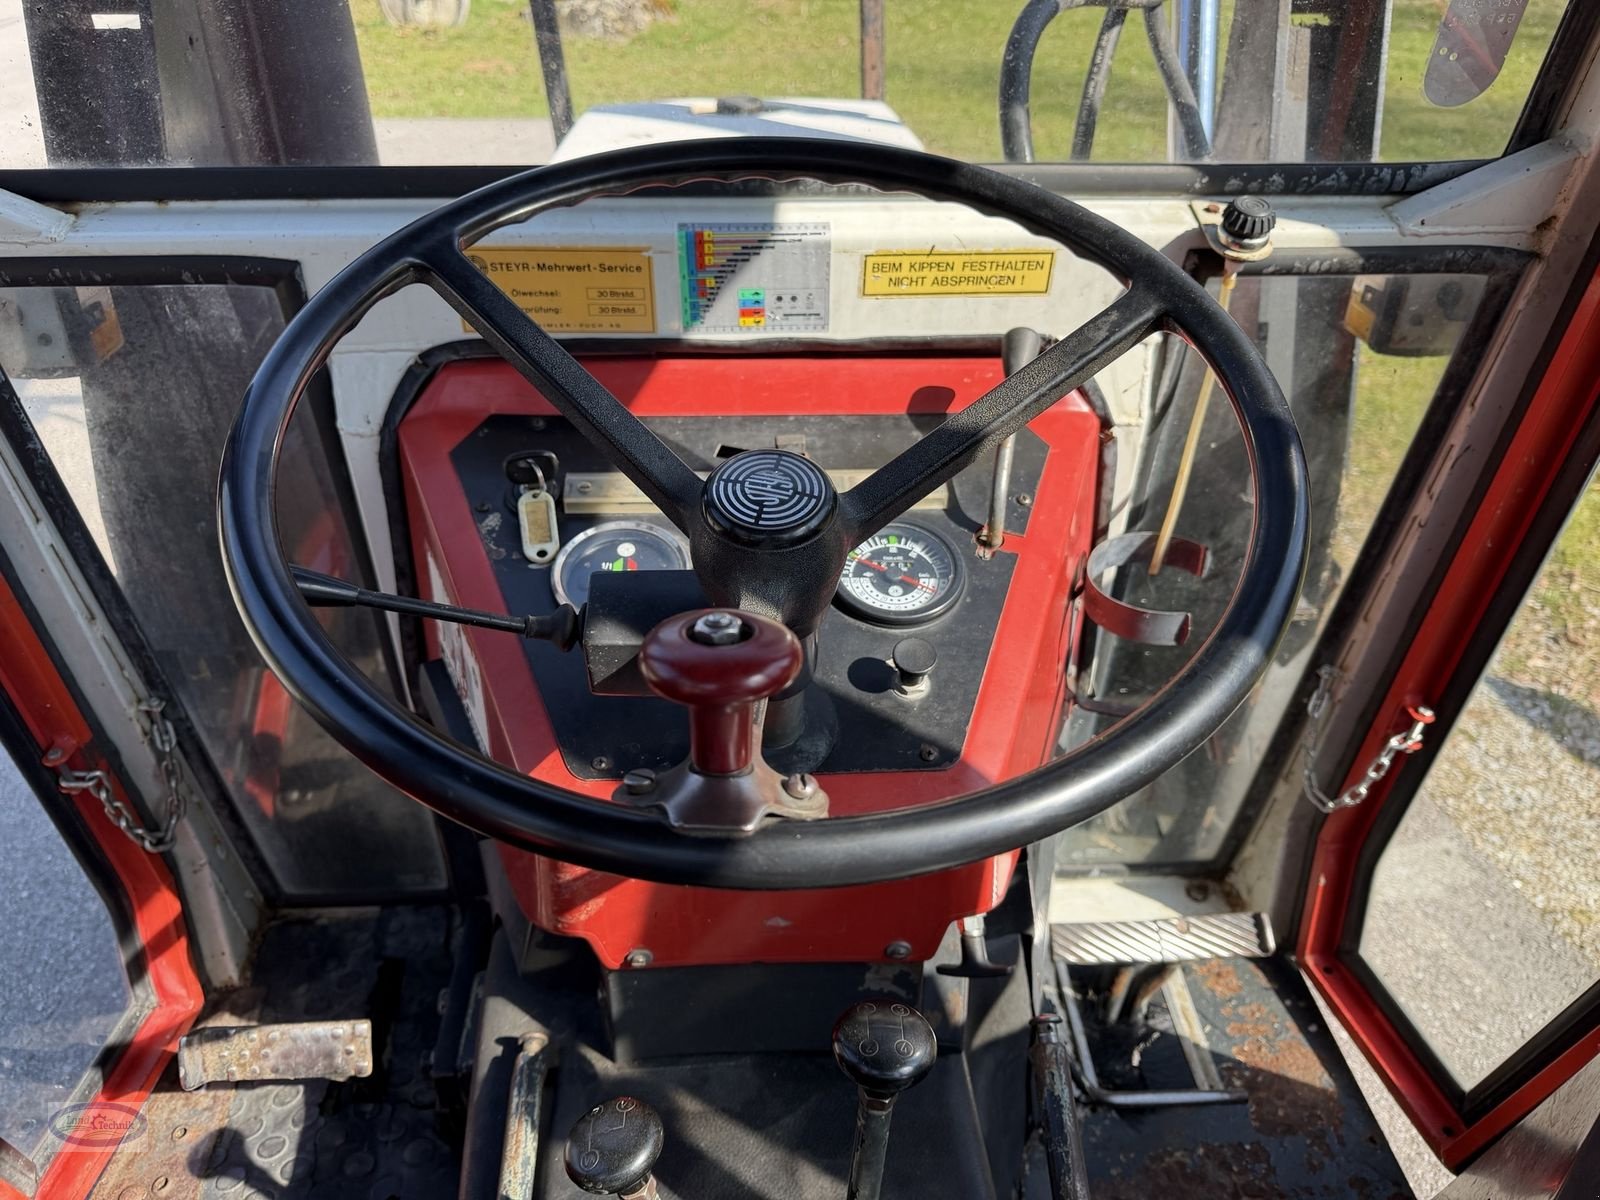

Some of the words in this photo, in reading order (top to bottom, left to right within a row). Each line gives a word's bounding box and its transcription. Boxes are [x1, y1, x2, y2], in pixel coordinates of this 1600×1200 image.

[871, 262, 902, 273] BEIM
[908, 261, 955, 272] KIPPEN
[961, 260, 1045, 272] FESTHALTEN
[888, 276, 926, 287] NICHT
[931, 275, 1016, 286] ABSPRINGEN
